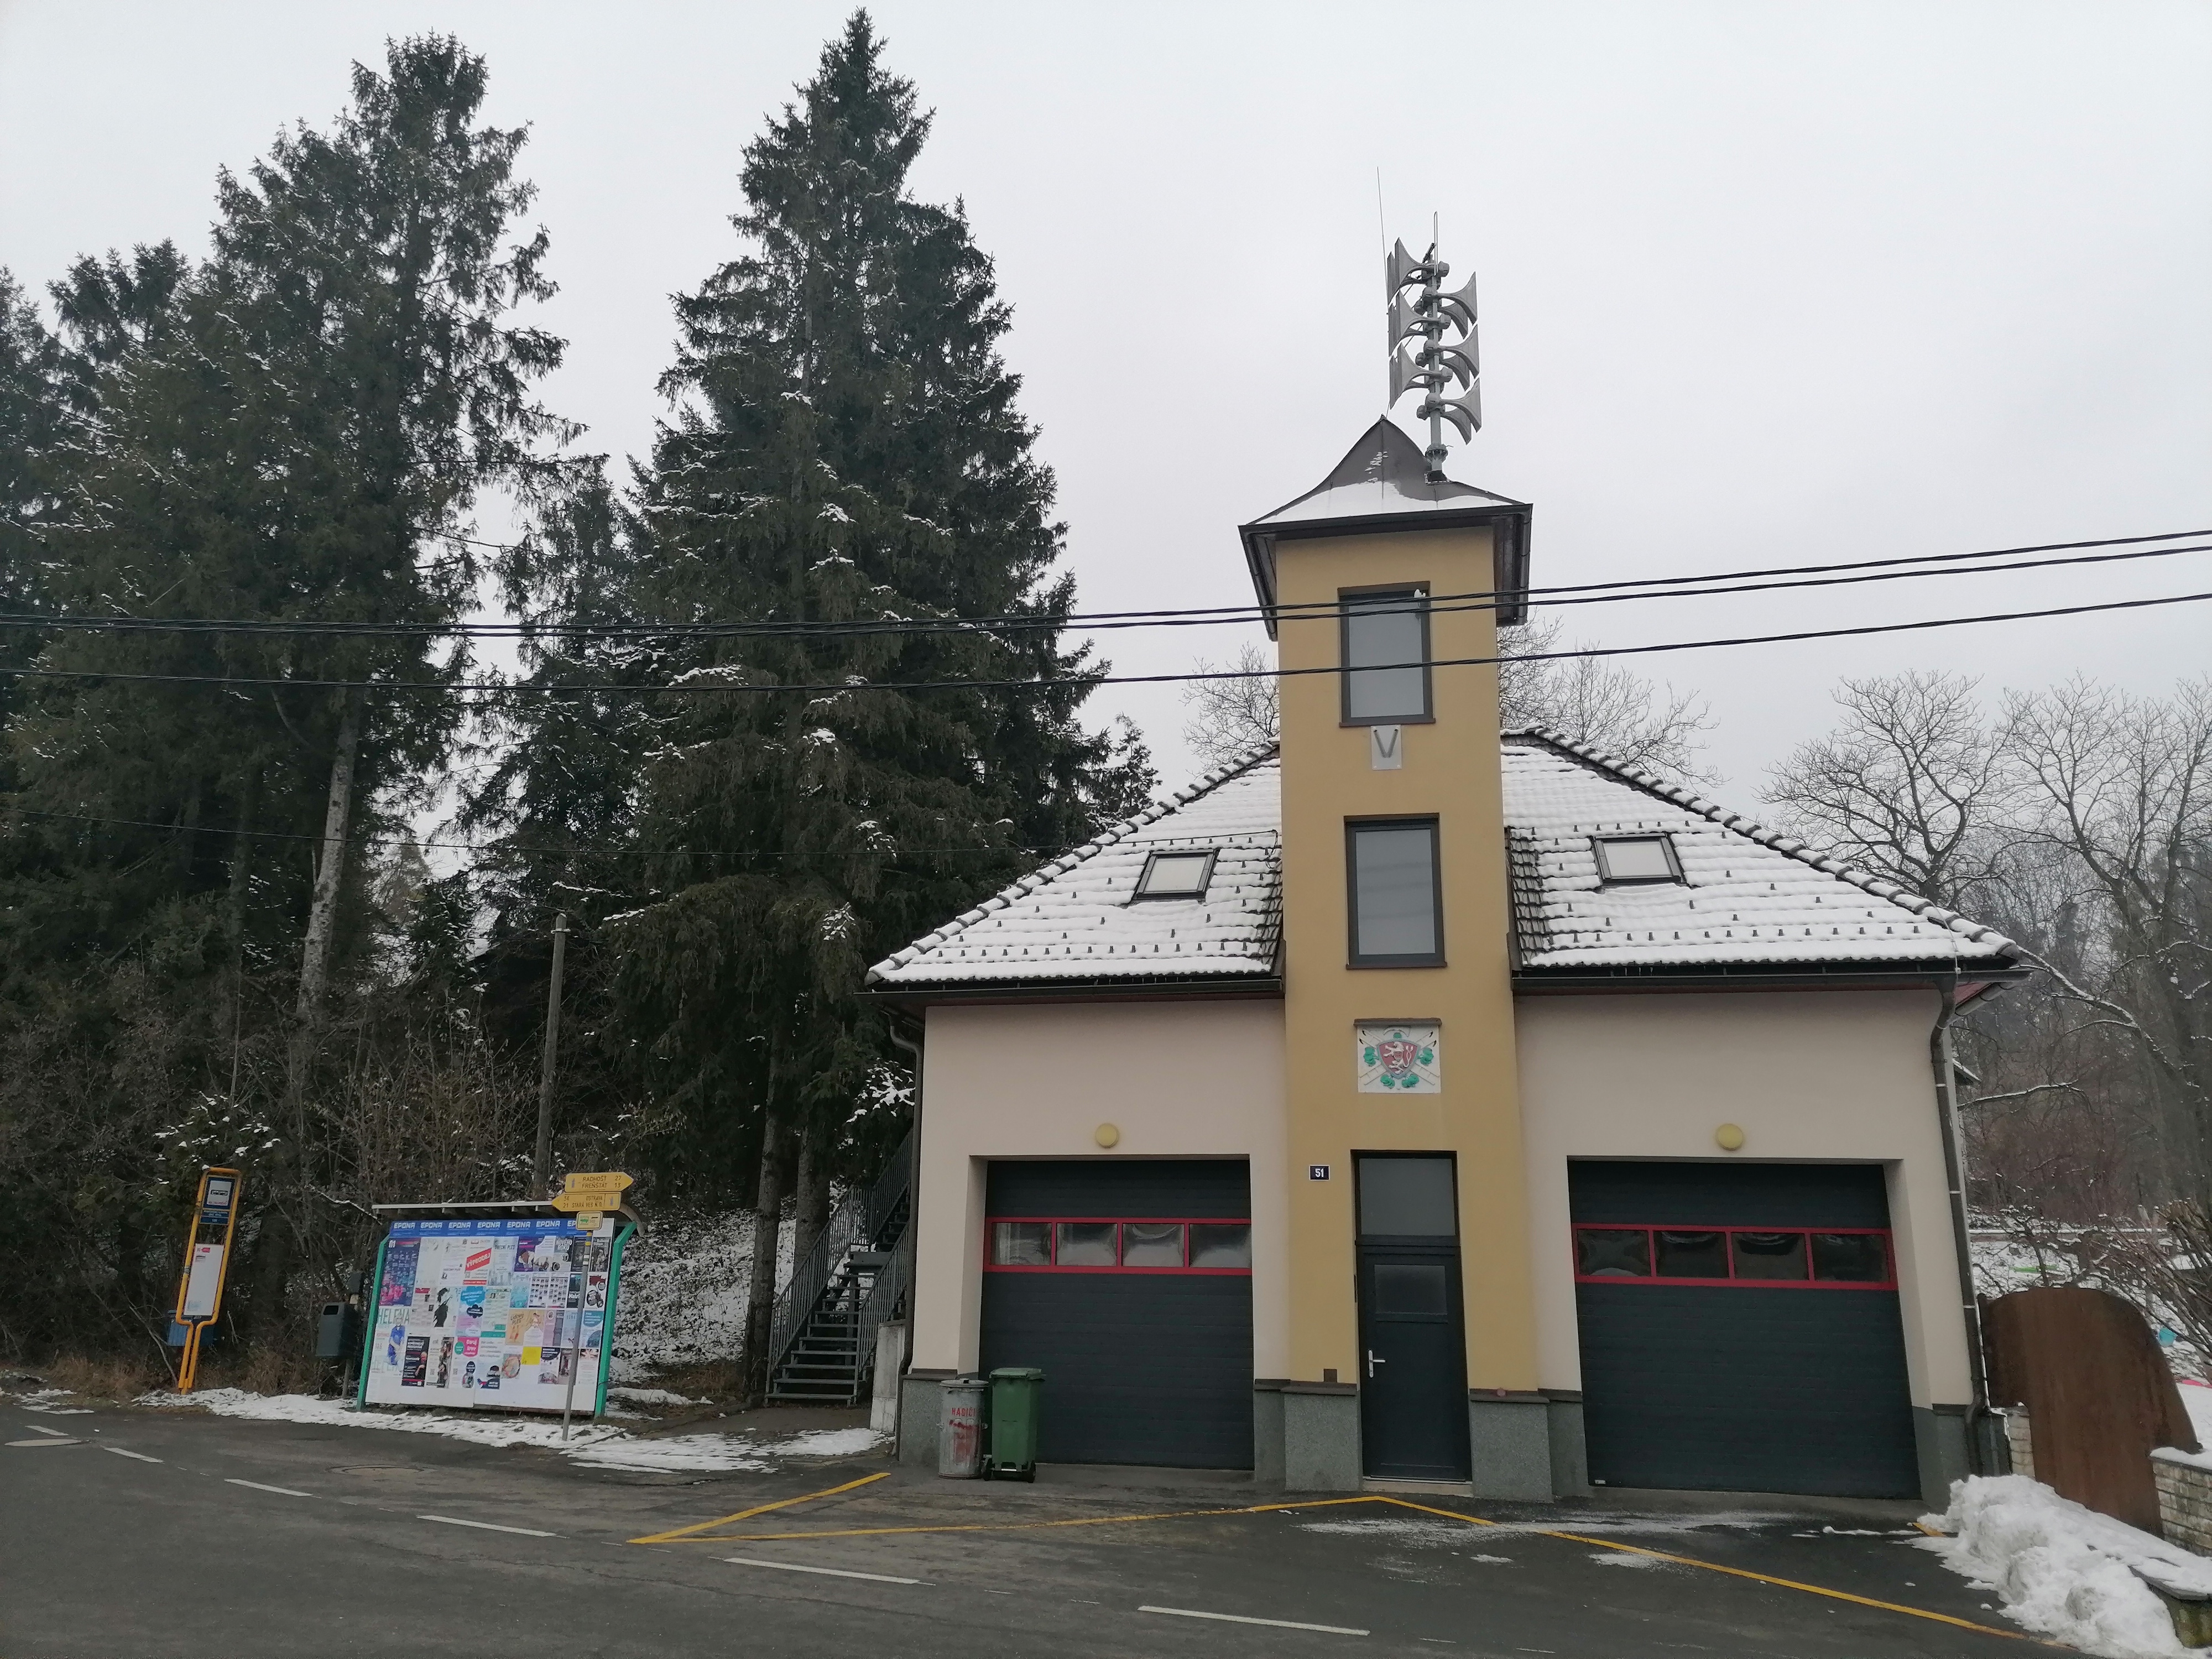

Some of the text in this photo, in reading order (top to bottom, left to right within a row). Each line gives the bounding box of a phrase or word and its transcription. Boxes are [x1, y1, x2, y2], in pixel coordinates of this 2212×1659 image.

[1315, 1168, 1324, 1177] 51
[466, 1253, 491, 1268] VÝPRODEJ
[952, 1407, 975, 1416] HASIČI
